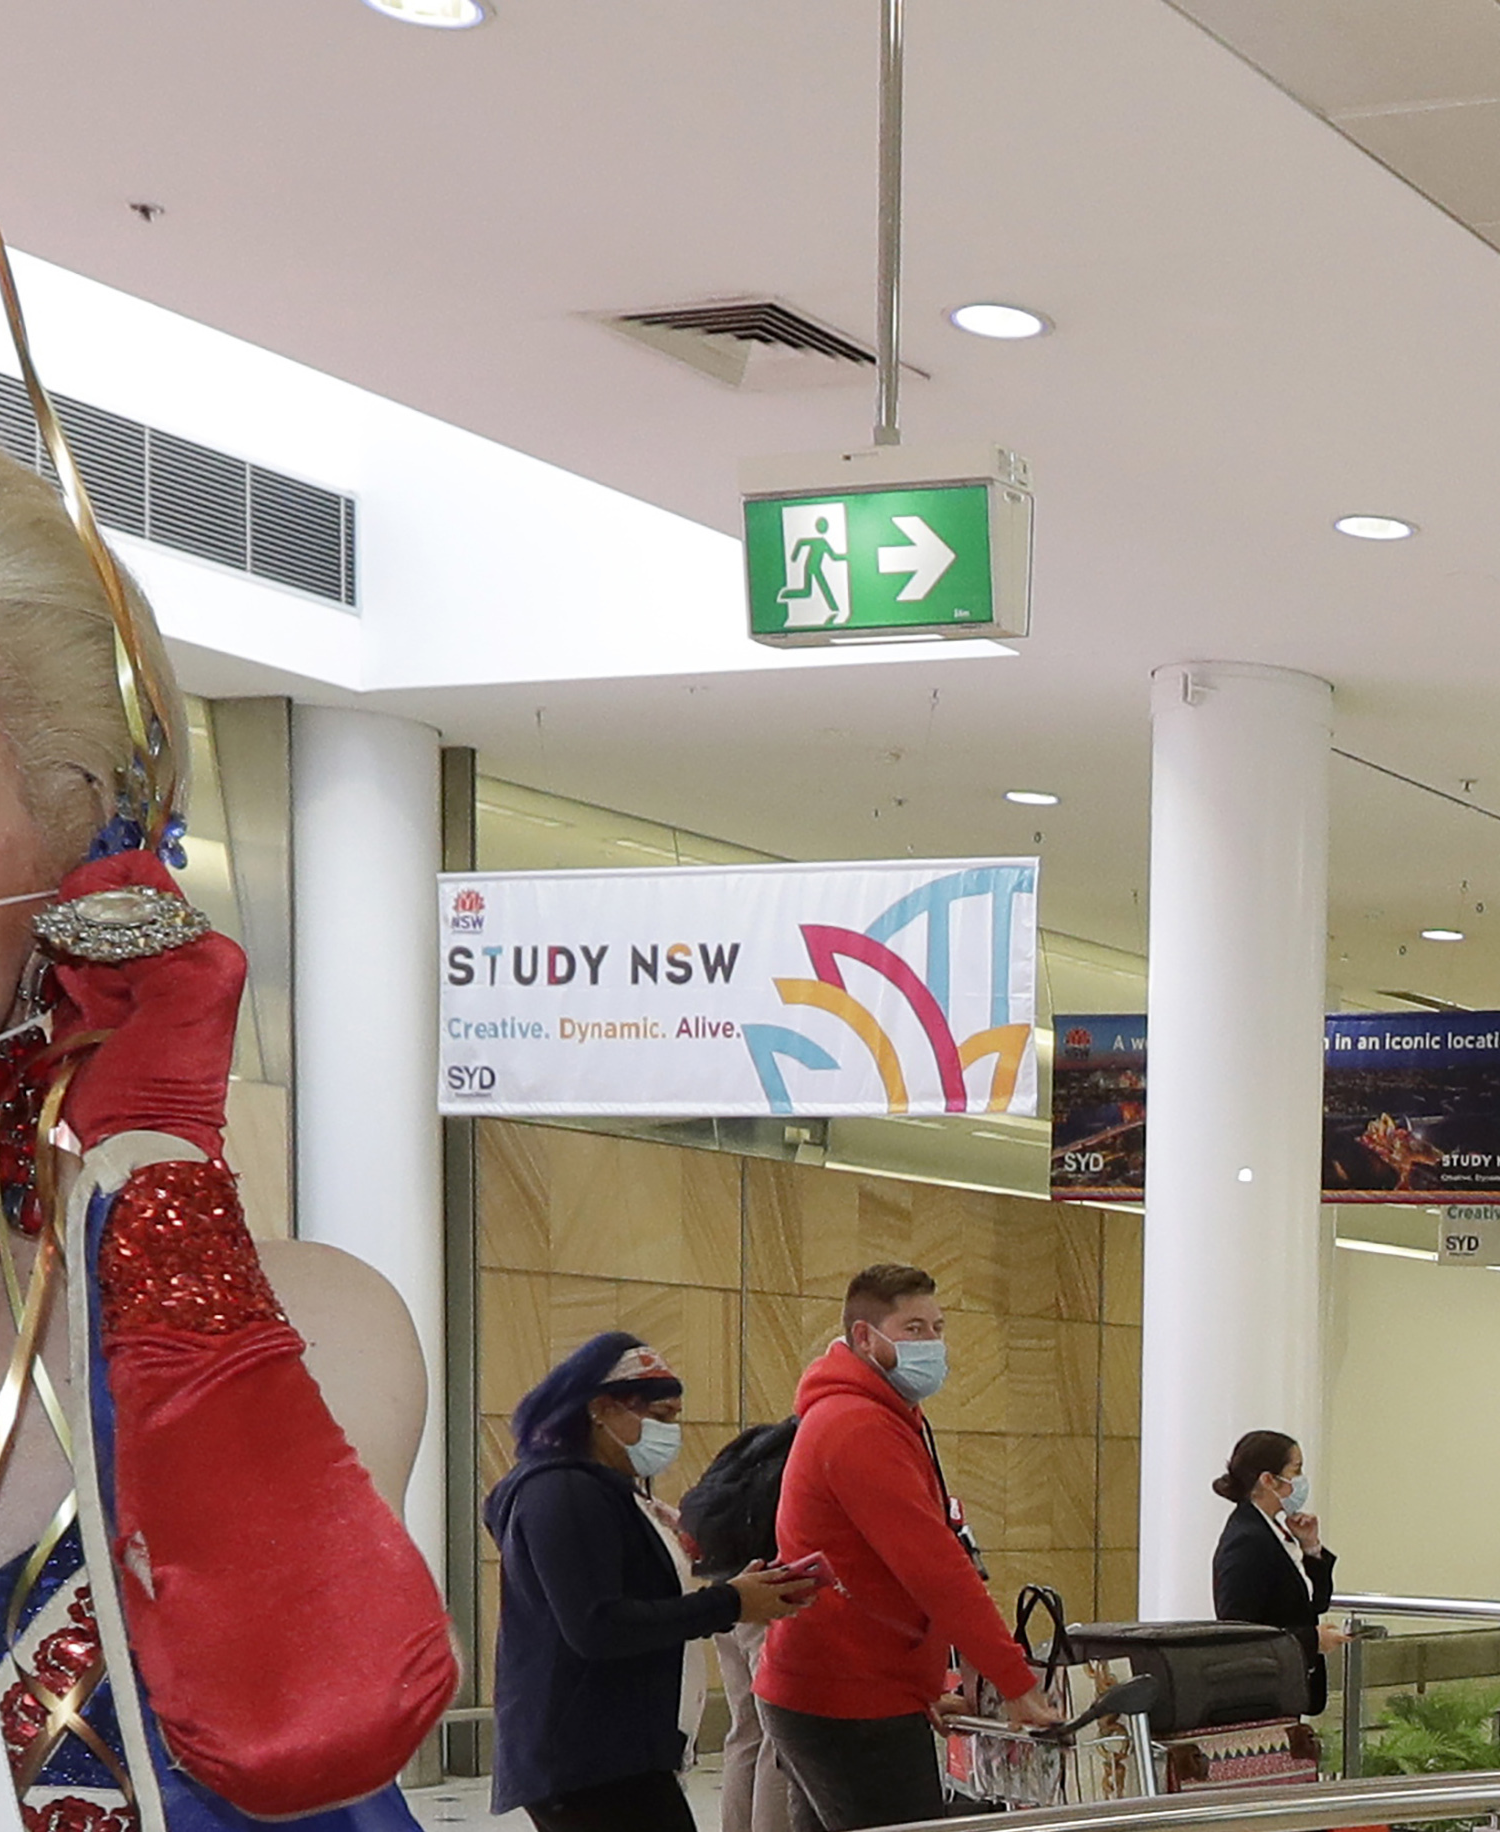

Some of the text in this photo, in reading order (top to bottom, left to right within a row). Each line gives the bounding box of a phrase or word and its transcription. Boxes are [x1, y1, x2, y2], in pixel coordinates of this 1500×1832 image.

[450, 916, 484, 930] NSW
[448, 943, 741, 986] STUDY NSW
[448, 1016, 742, 1044] Creative. Dynamic. Alive.
[1112, 1034, 1126, 1052] A
[1334, 1032, 1352, 1051] in
[1357, 1034, 1380, 1051] an
[1384, 1031, 1441, 1050] iconic
[447, 1065, 496, 1091] SYD
[1063, 1152, 1105, 1173] SYD
[1442, 1154, 1493, 1168] STUDY
[1445, 1235, 1480, 1252] SYD
